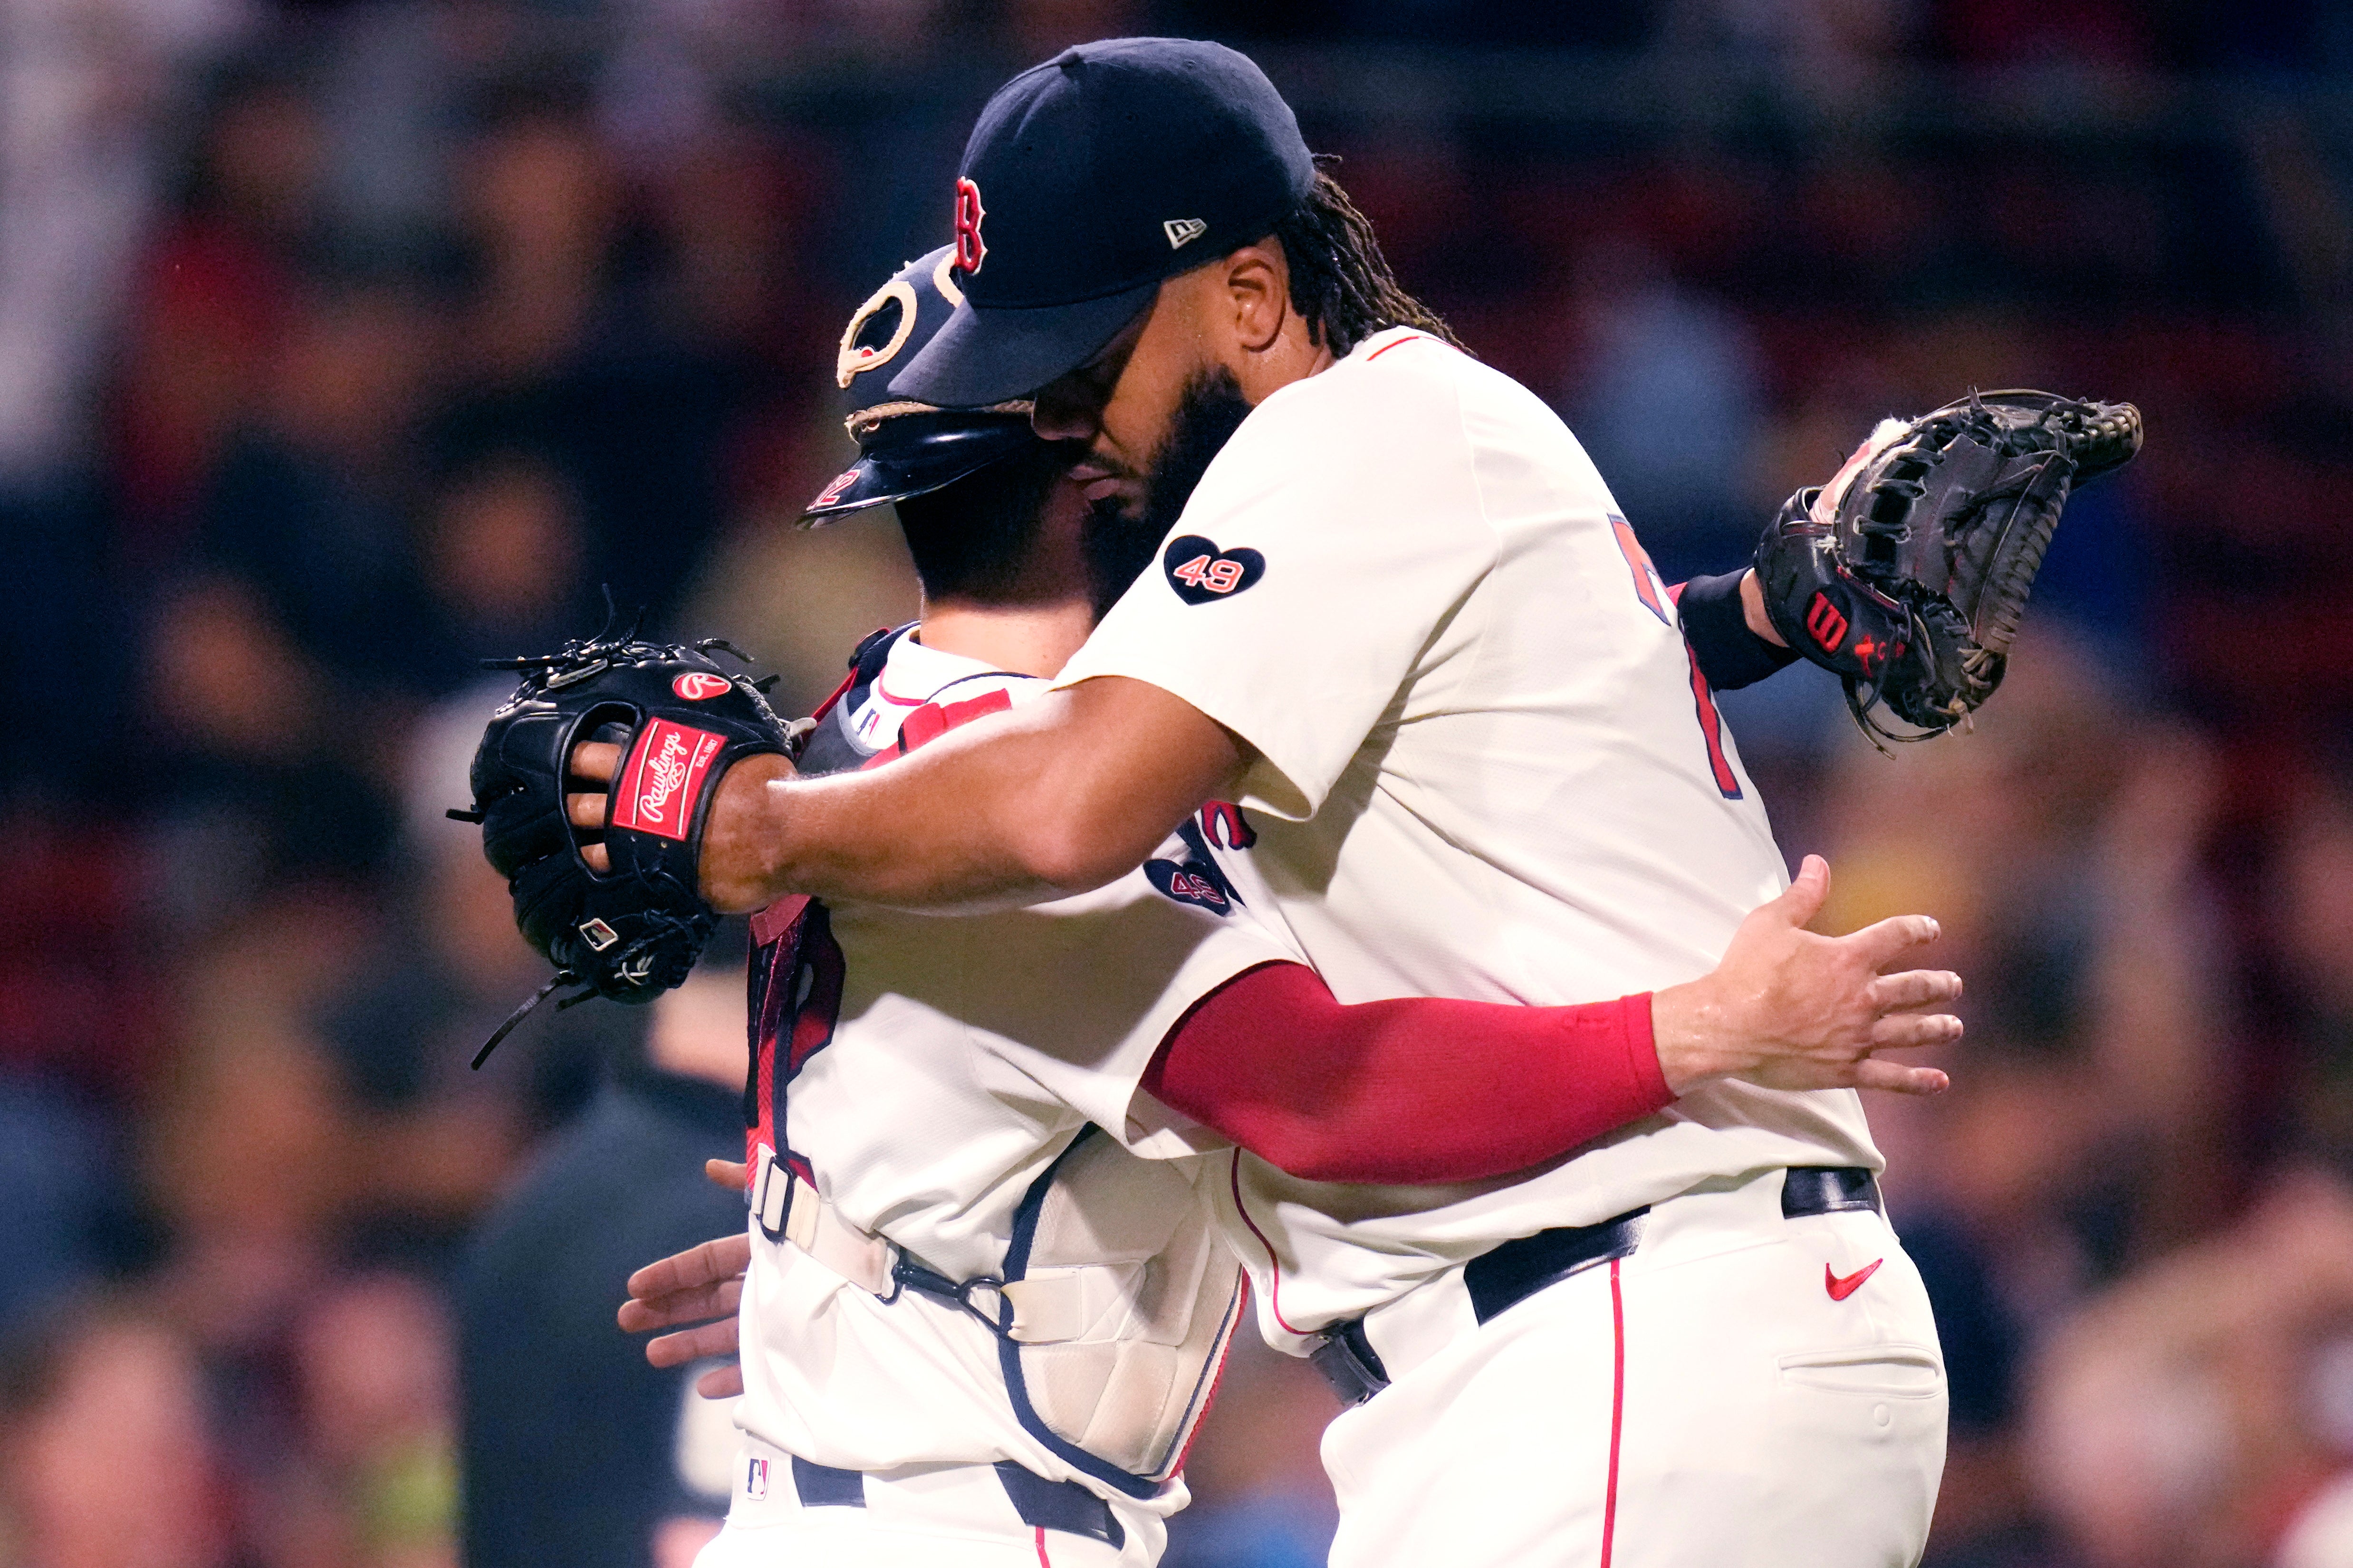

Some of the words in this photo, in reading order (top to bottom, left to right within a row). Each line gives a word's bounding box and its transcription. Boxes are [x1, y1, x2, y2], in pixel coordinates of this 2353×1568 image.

[955, 175, 987, 275] B
[1173, 554, 1244, 593] 49
[695, 754, 710, 768] Est.
[703, 739, 719, 754] 1887
[640, 731, 688, 822] Rawlings
[1170, 871, 1226, 905] 49
